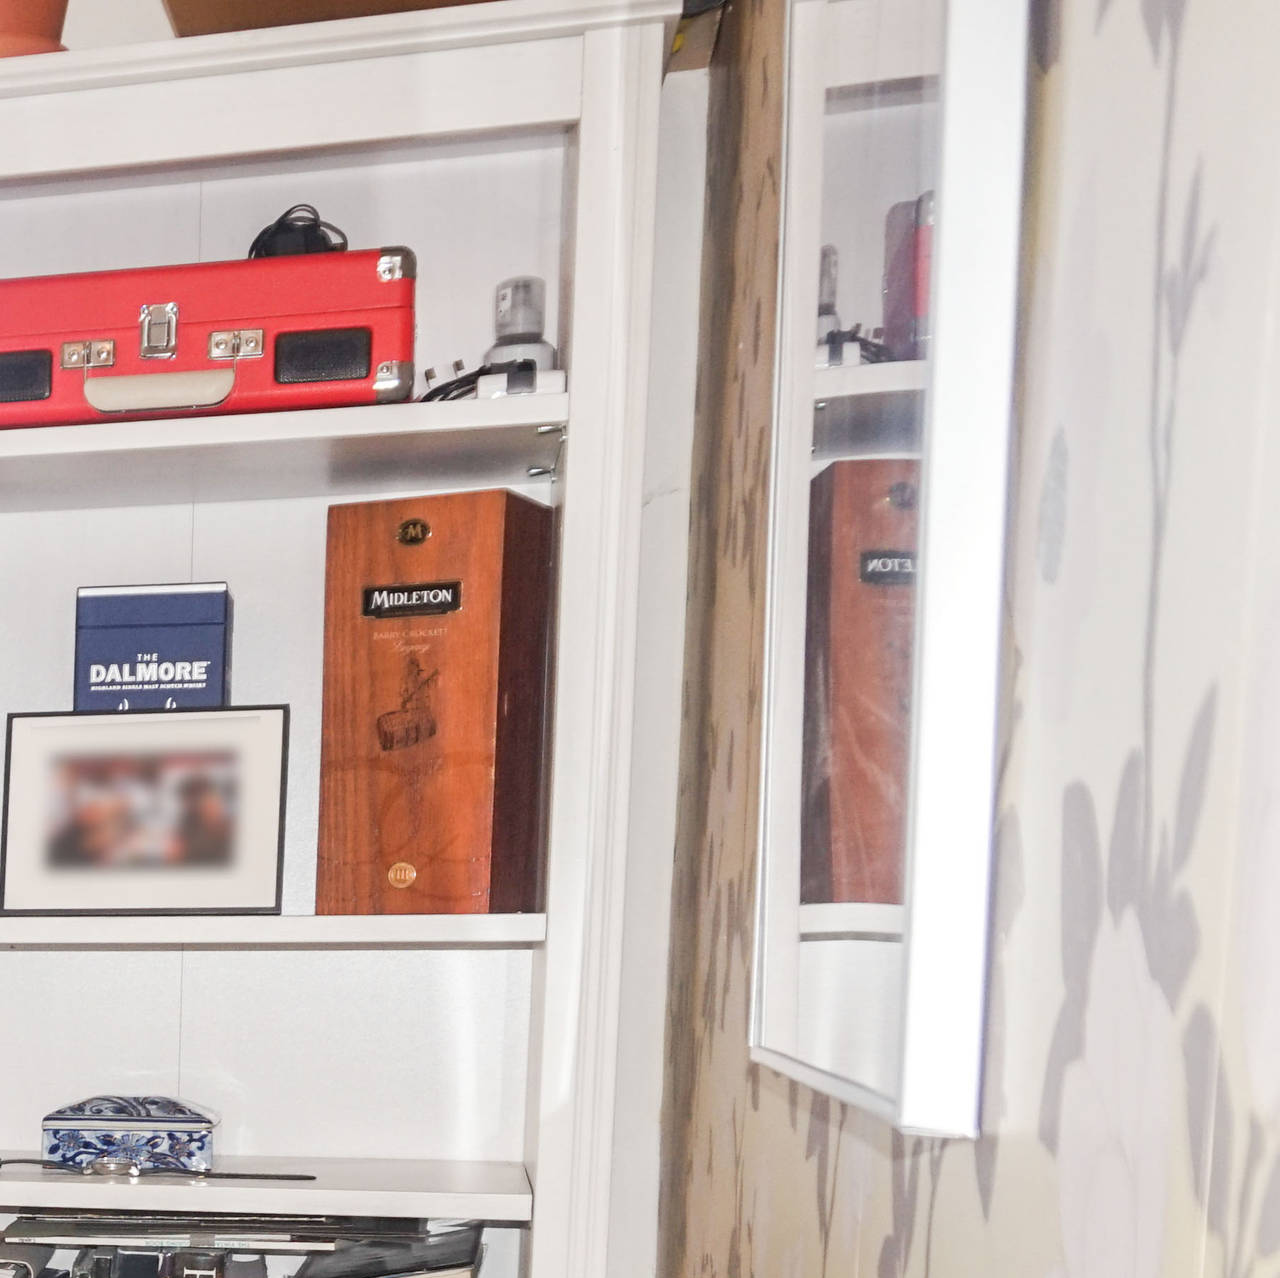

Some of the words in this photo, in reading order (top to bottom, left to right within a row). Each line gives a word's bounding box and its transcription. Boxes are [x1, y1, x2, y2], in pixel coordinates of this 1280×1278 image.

[370, 588, 452, 609] MIDLETON
[137, 653, 159, 661] THE
[90, 660, 208, 684] DALMORE
